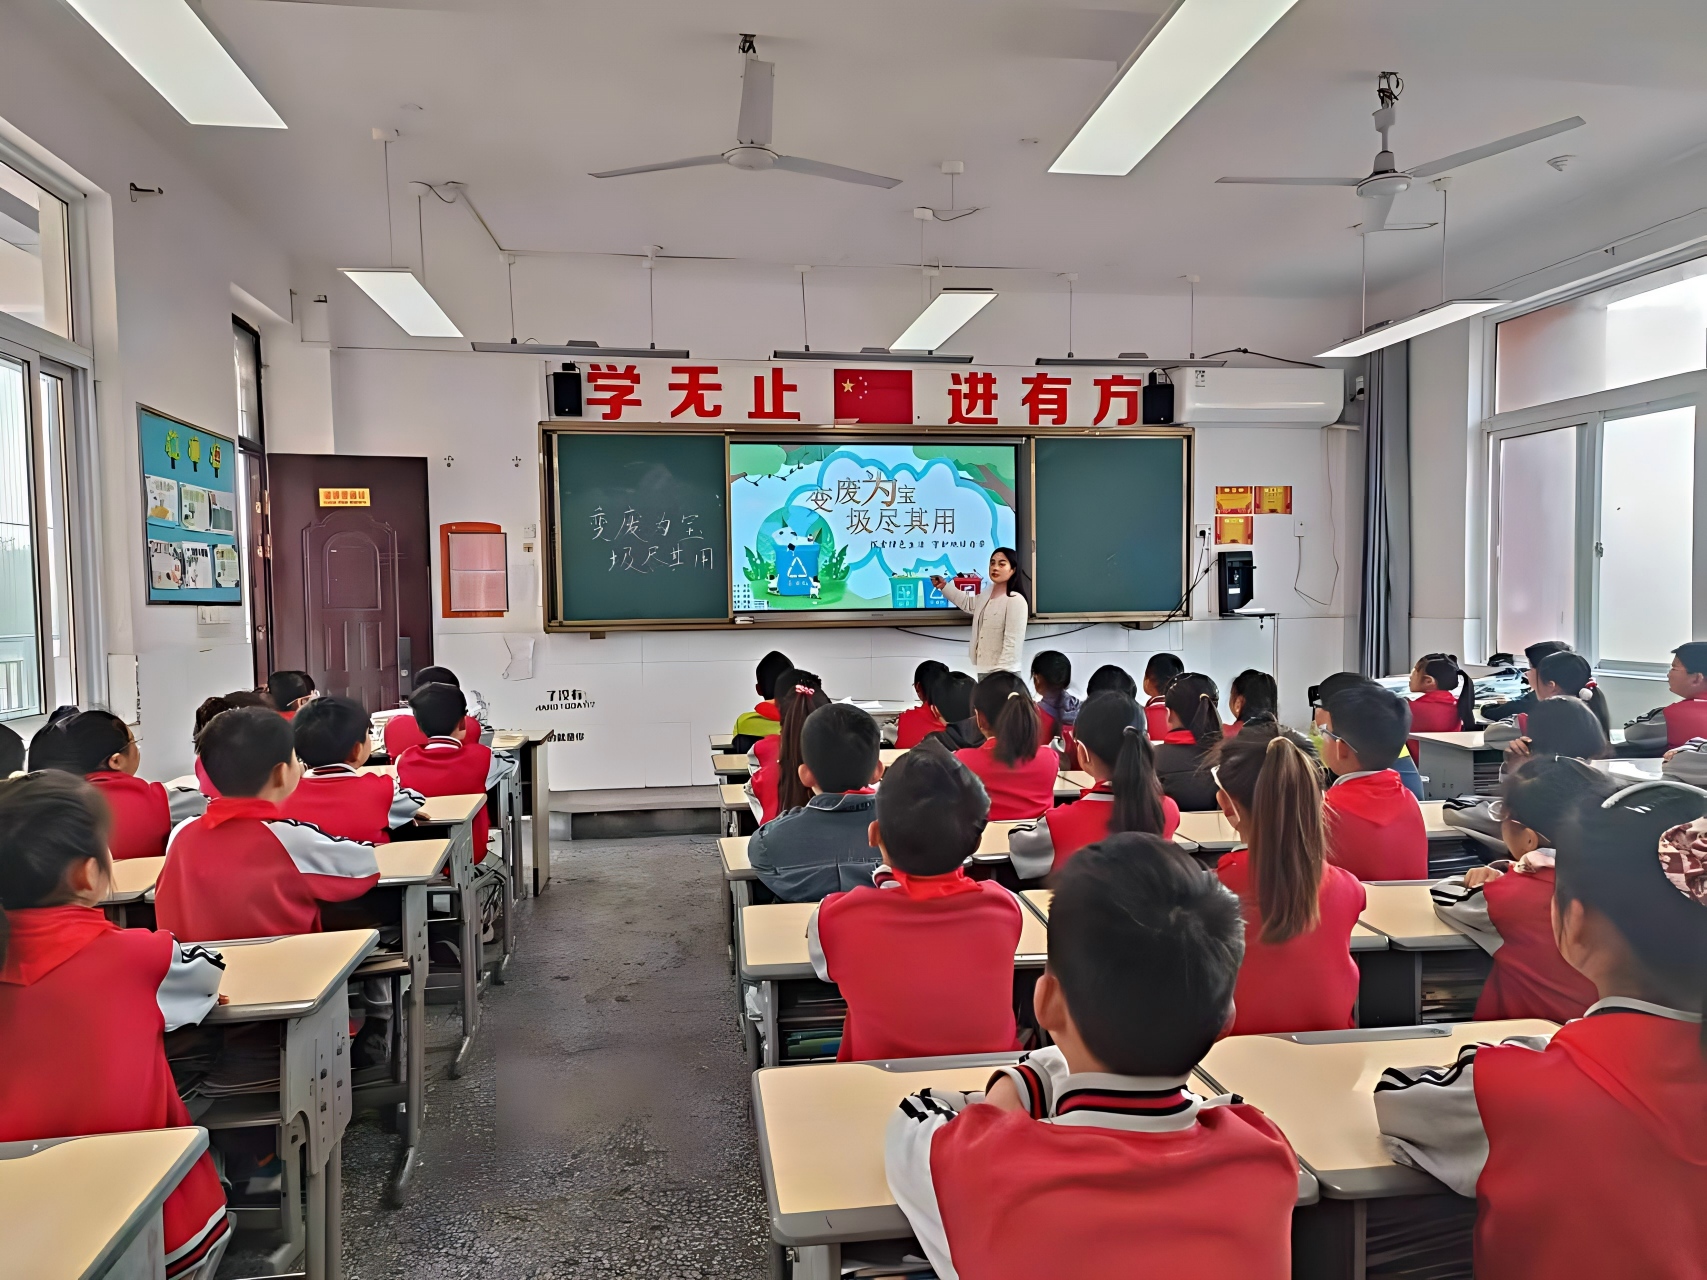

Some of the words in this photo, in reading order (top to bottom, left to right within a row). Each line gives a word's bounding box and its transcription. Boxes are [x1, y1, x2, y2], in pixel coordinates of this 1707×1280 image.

[587, 364, 801, 421] 学无止
[947, 371, 1142, 426] 进有方
[806, 470, 916, 512] 变废为宝
[846, 507, 955, 534] 圾尽其用
